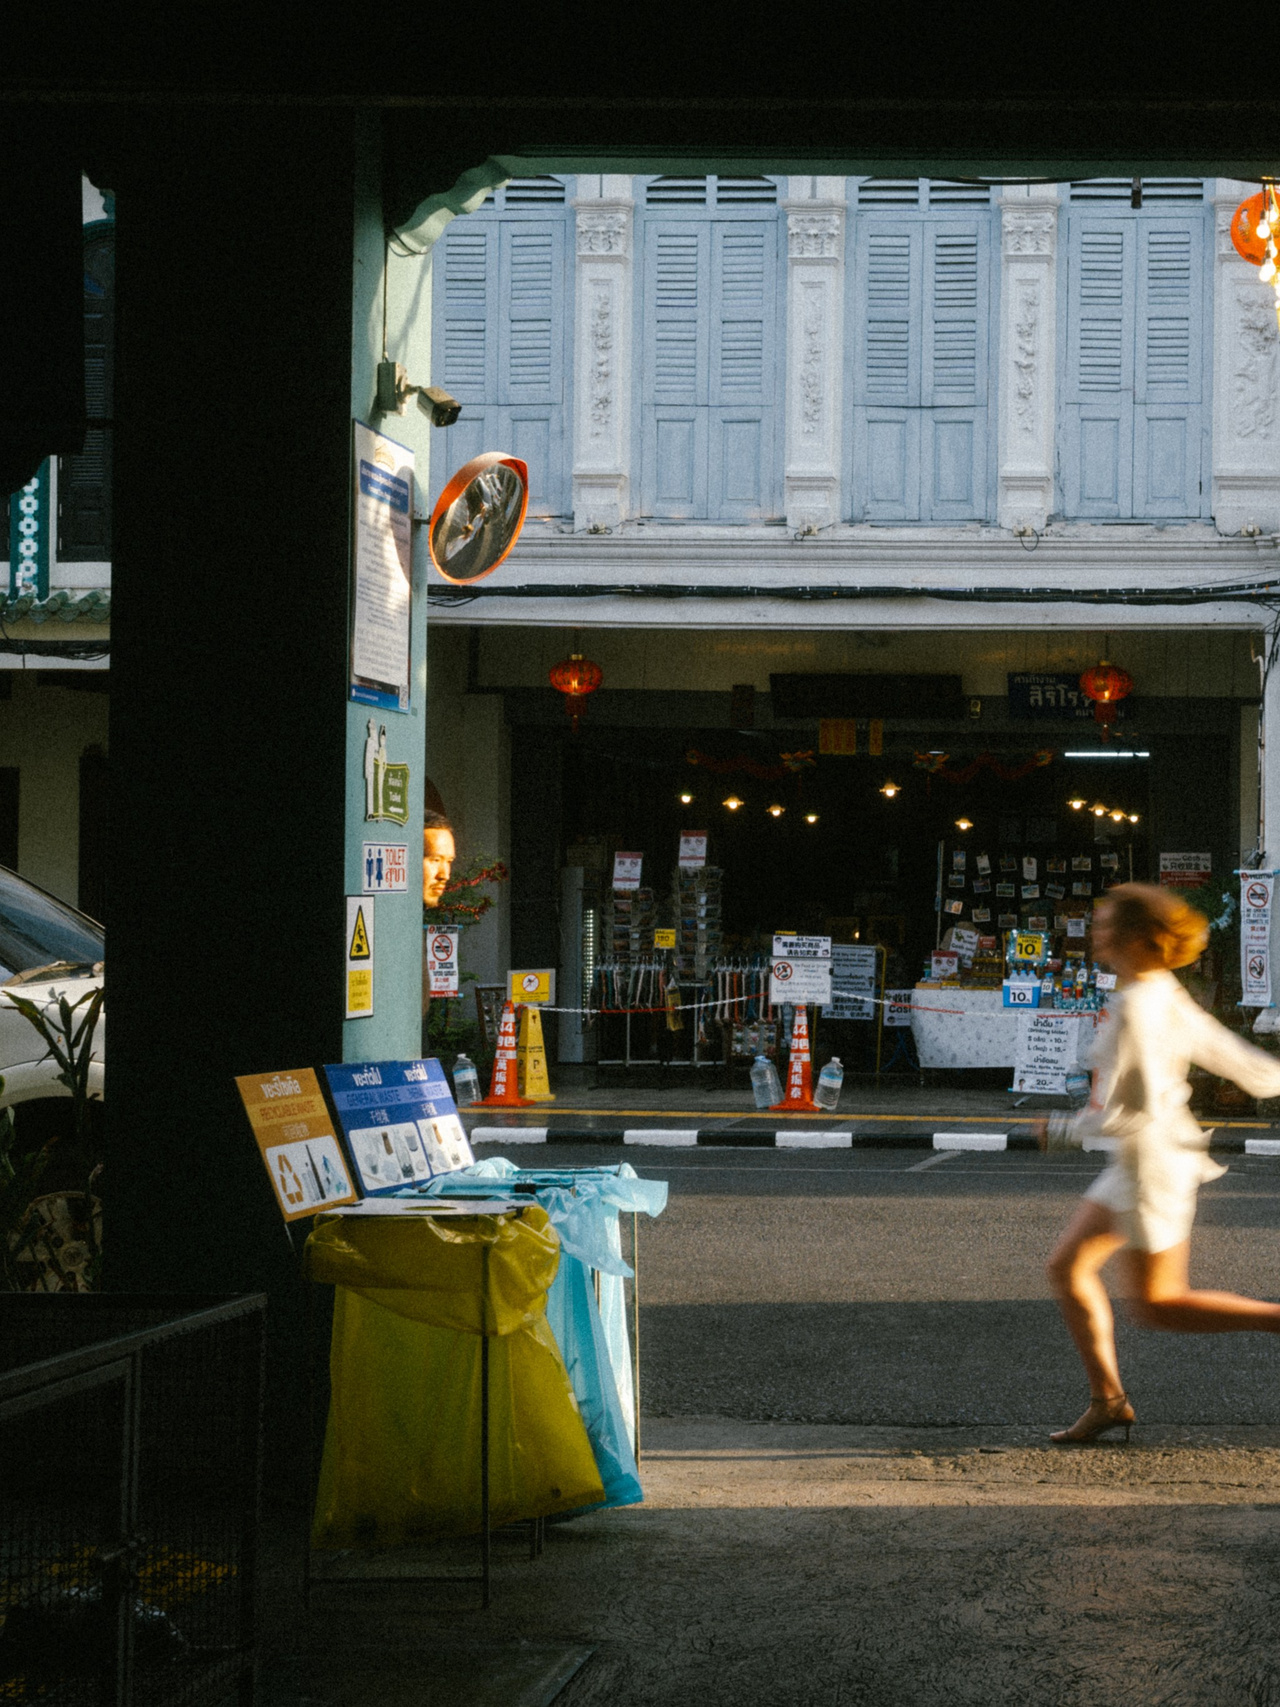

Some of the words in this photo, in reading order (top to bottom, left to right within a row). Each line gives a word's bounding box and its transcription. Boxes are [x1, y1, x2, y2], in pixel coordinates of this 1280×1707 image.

[384, 848, 407, 867] TOILET
[1017, 942, 1036, 956] 10
[1098, 975, 1109, 984] 20
[1011, 991, 1027, 1002] 10
[352, 1065, 383, 1087] ขยะทั่วไป
[260, 1075, 302, 1098] ขยะรีไซเคิล
[346, 1090, 378, 1107] GENERAL
[378, 1088, 401, 1102] WASTE
[260, 1103, 299, 1121] RECYCLABLE
[298, 1100, 317, 1114] WASTE
